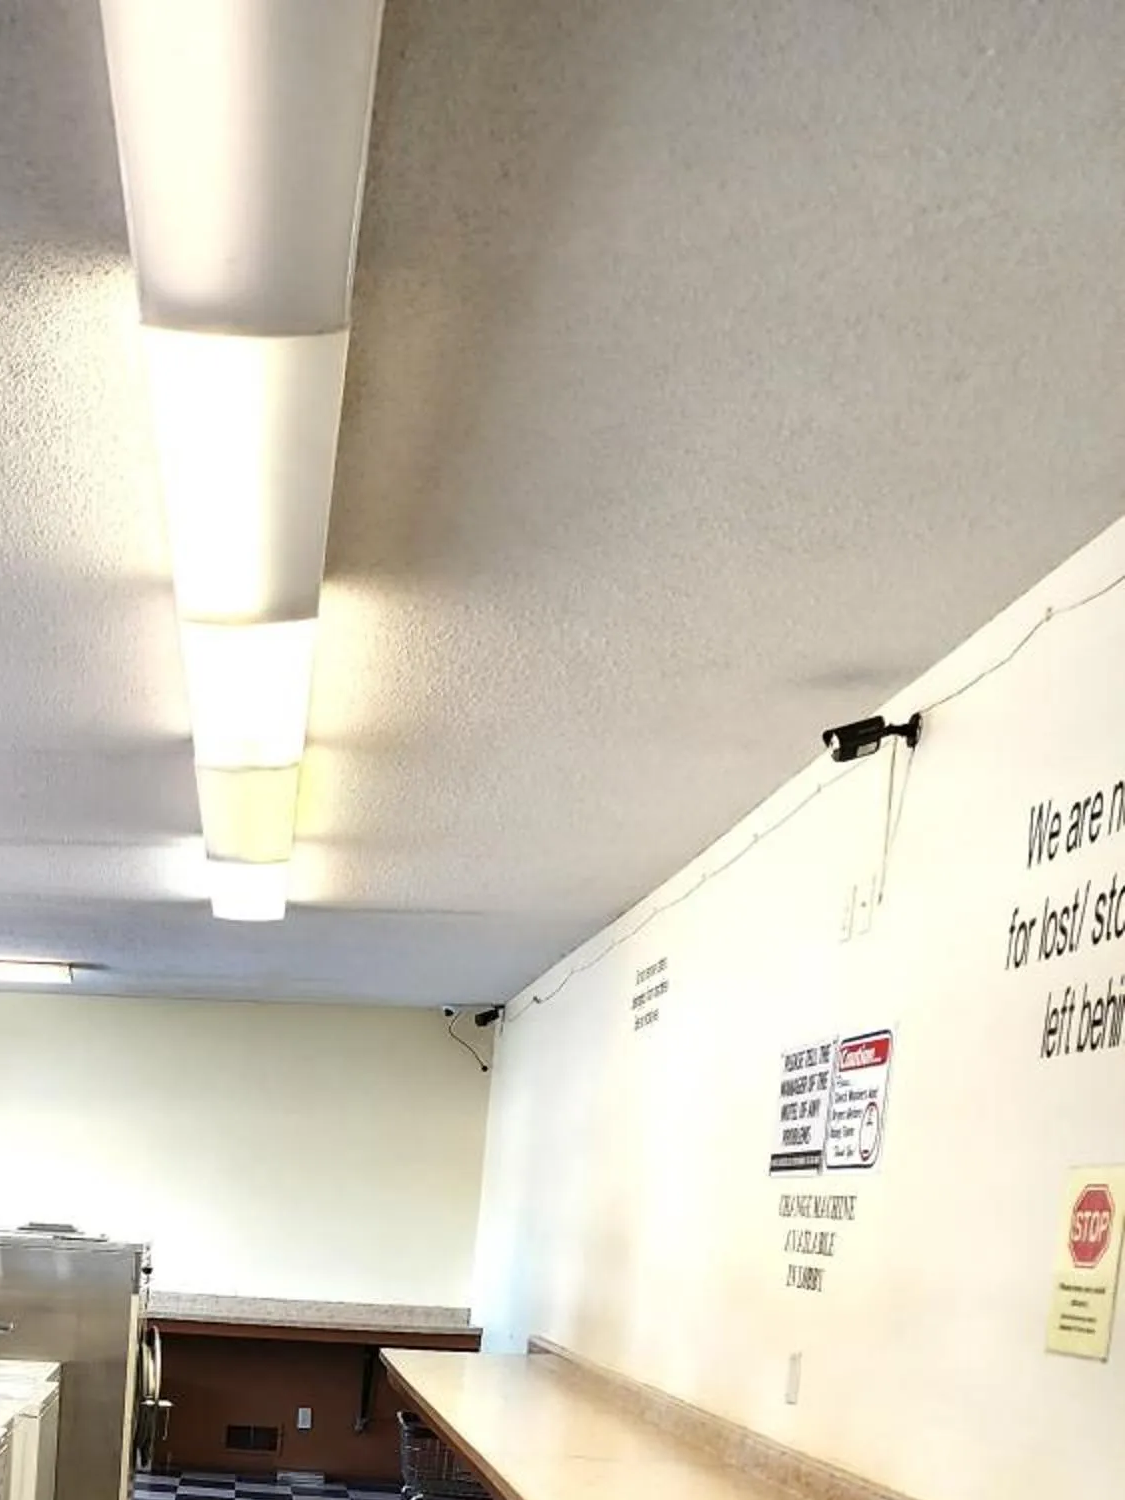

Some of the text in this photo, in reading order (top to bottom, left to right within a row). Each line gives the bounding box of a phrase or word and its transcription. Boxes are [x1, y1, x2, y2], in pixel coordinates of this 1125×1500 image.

[1027, 780, 1125, 868] We are n
[1005, 906, 1037, 970] for
[1038, 879, 1091, 961] lost/
[1040, 985, 1075, 1058] left
[778, 1194, 857, 1221] CHANGE MACHINE
[1073, 1210, 1110, 1243] STOP
[784, 1229, 836, 1256] AVAILABLE
